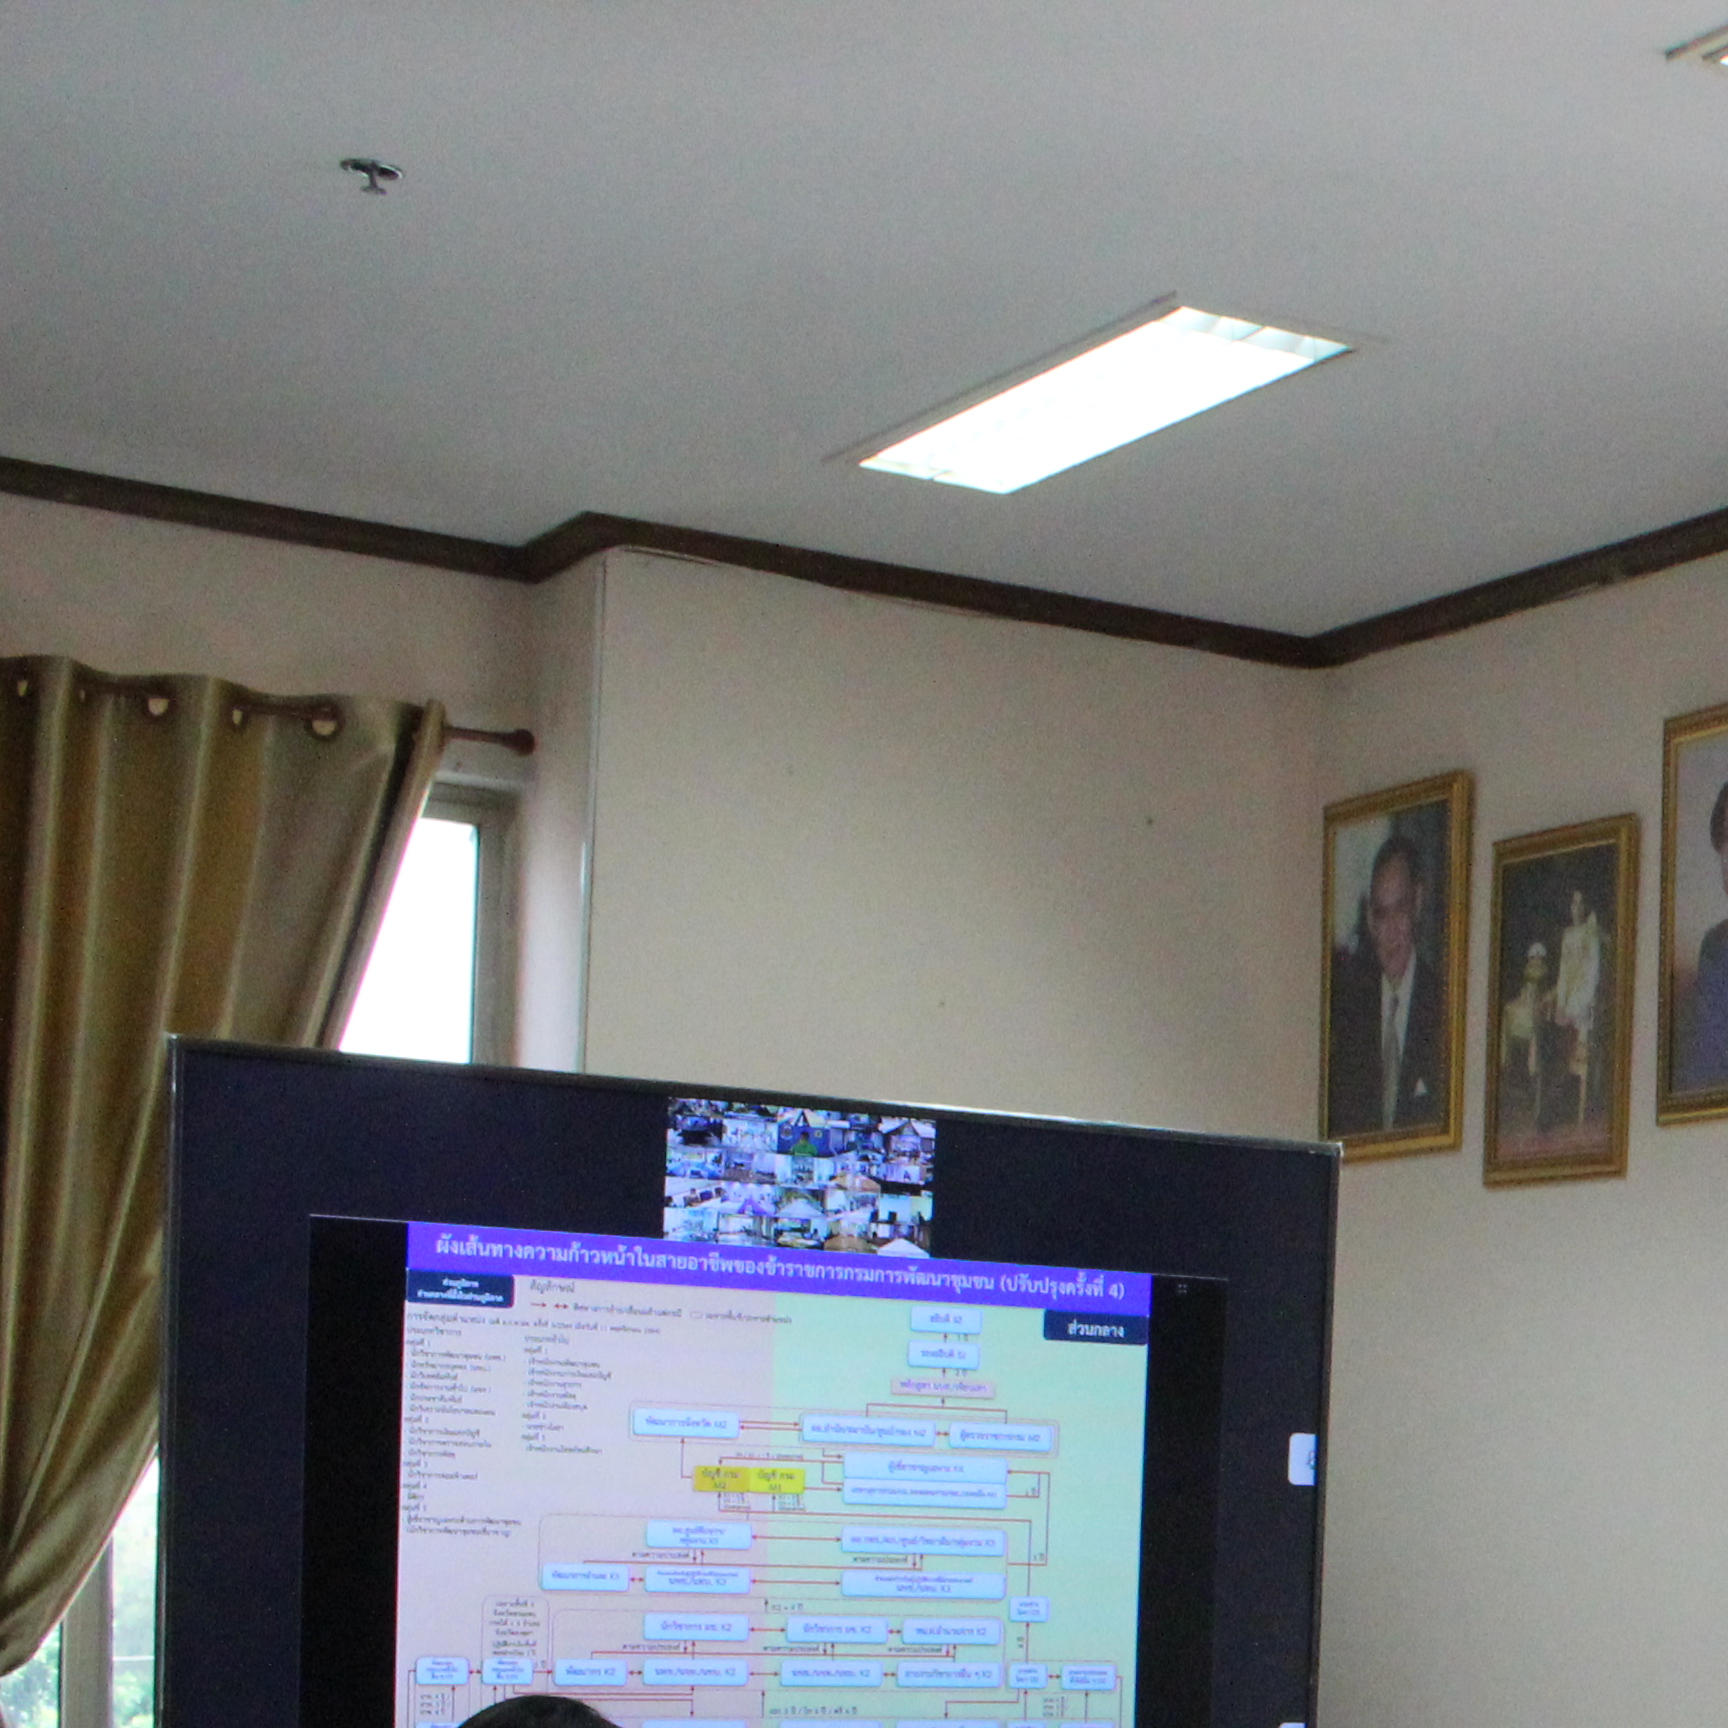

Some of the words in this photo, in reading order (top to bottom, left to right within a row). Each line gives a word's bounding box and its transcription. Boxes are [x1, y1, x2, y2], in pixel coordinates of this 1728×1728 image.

[435, 1232, 994, 1294] ผังเส้นทางความก้าวหน้าในสายอาชีพของข้าราชการกรมการพัฒนาชุมชน
[1108, 1281, 1125, 1299] 4)
[1067, 1319, 1125, 1339] ส่วนกลาง
